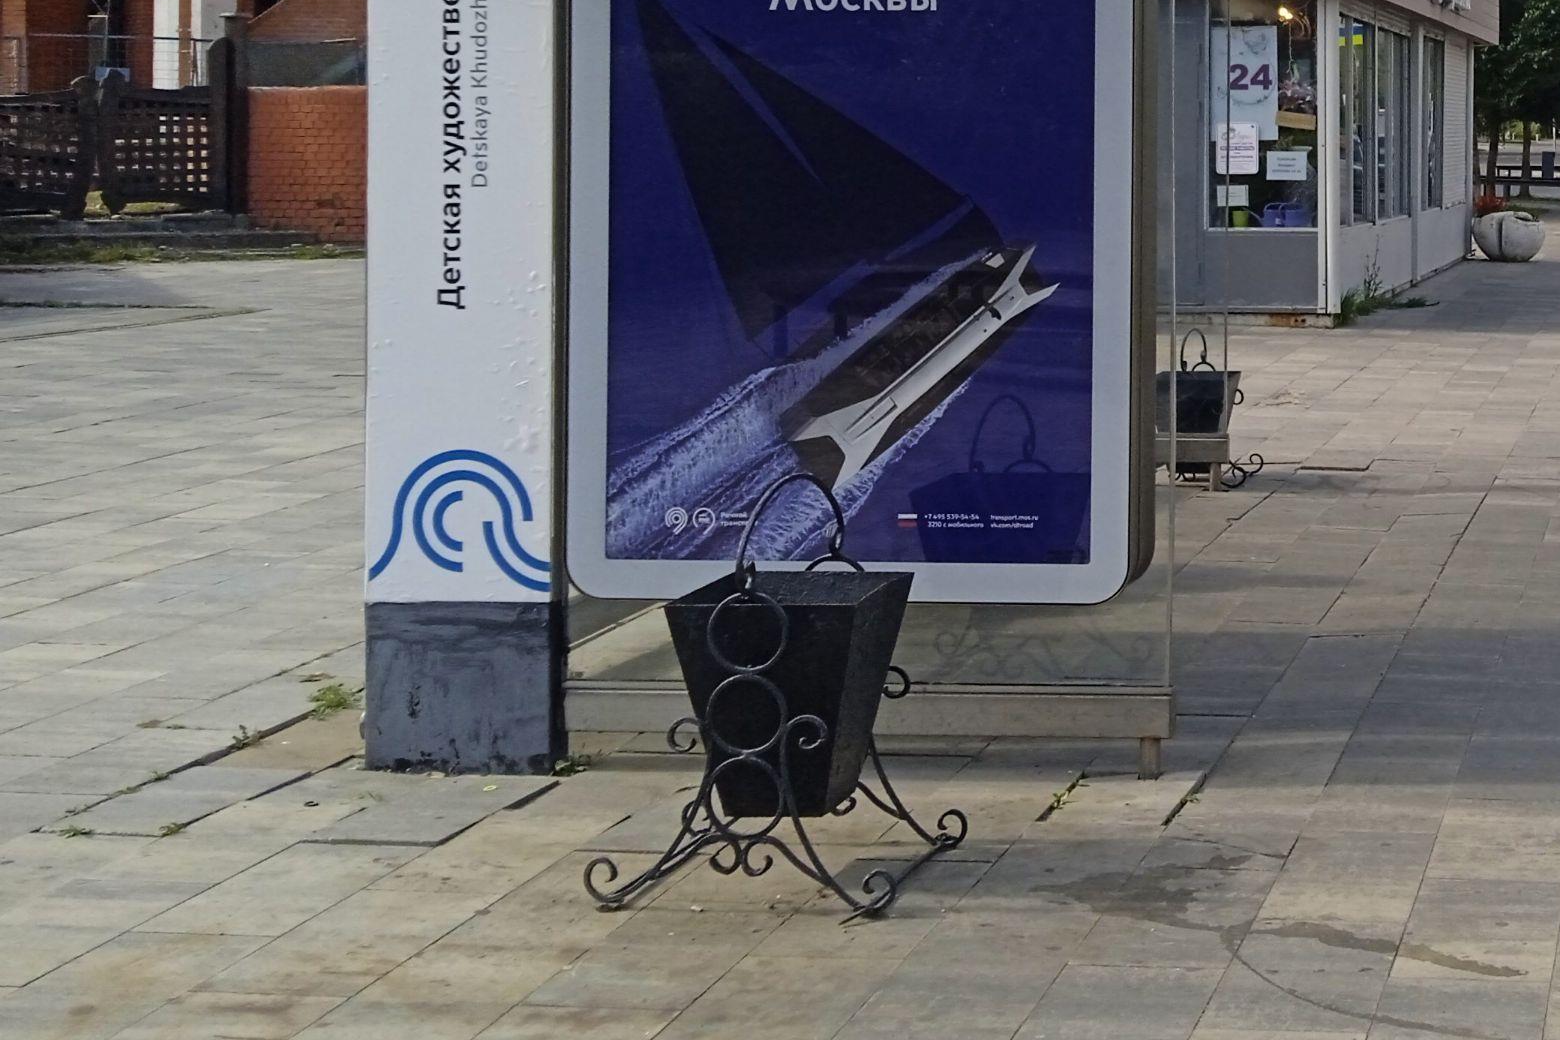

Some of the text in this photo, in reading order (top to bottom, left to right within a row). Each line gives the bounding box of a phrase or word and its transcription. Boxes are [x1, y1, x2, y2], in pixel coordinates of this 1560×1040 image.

[1229, 63, 1273, 91] 24
[470, 95, 491, 188] Detskaya
[437, 183, 466, 310] Детская
